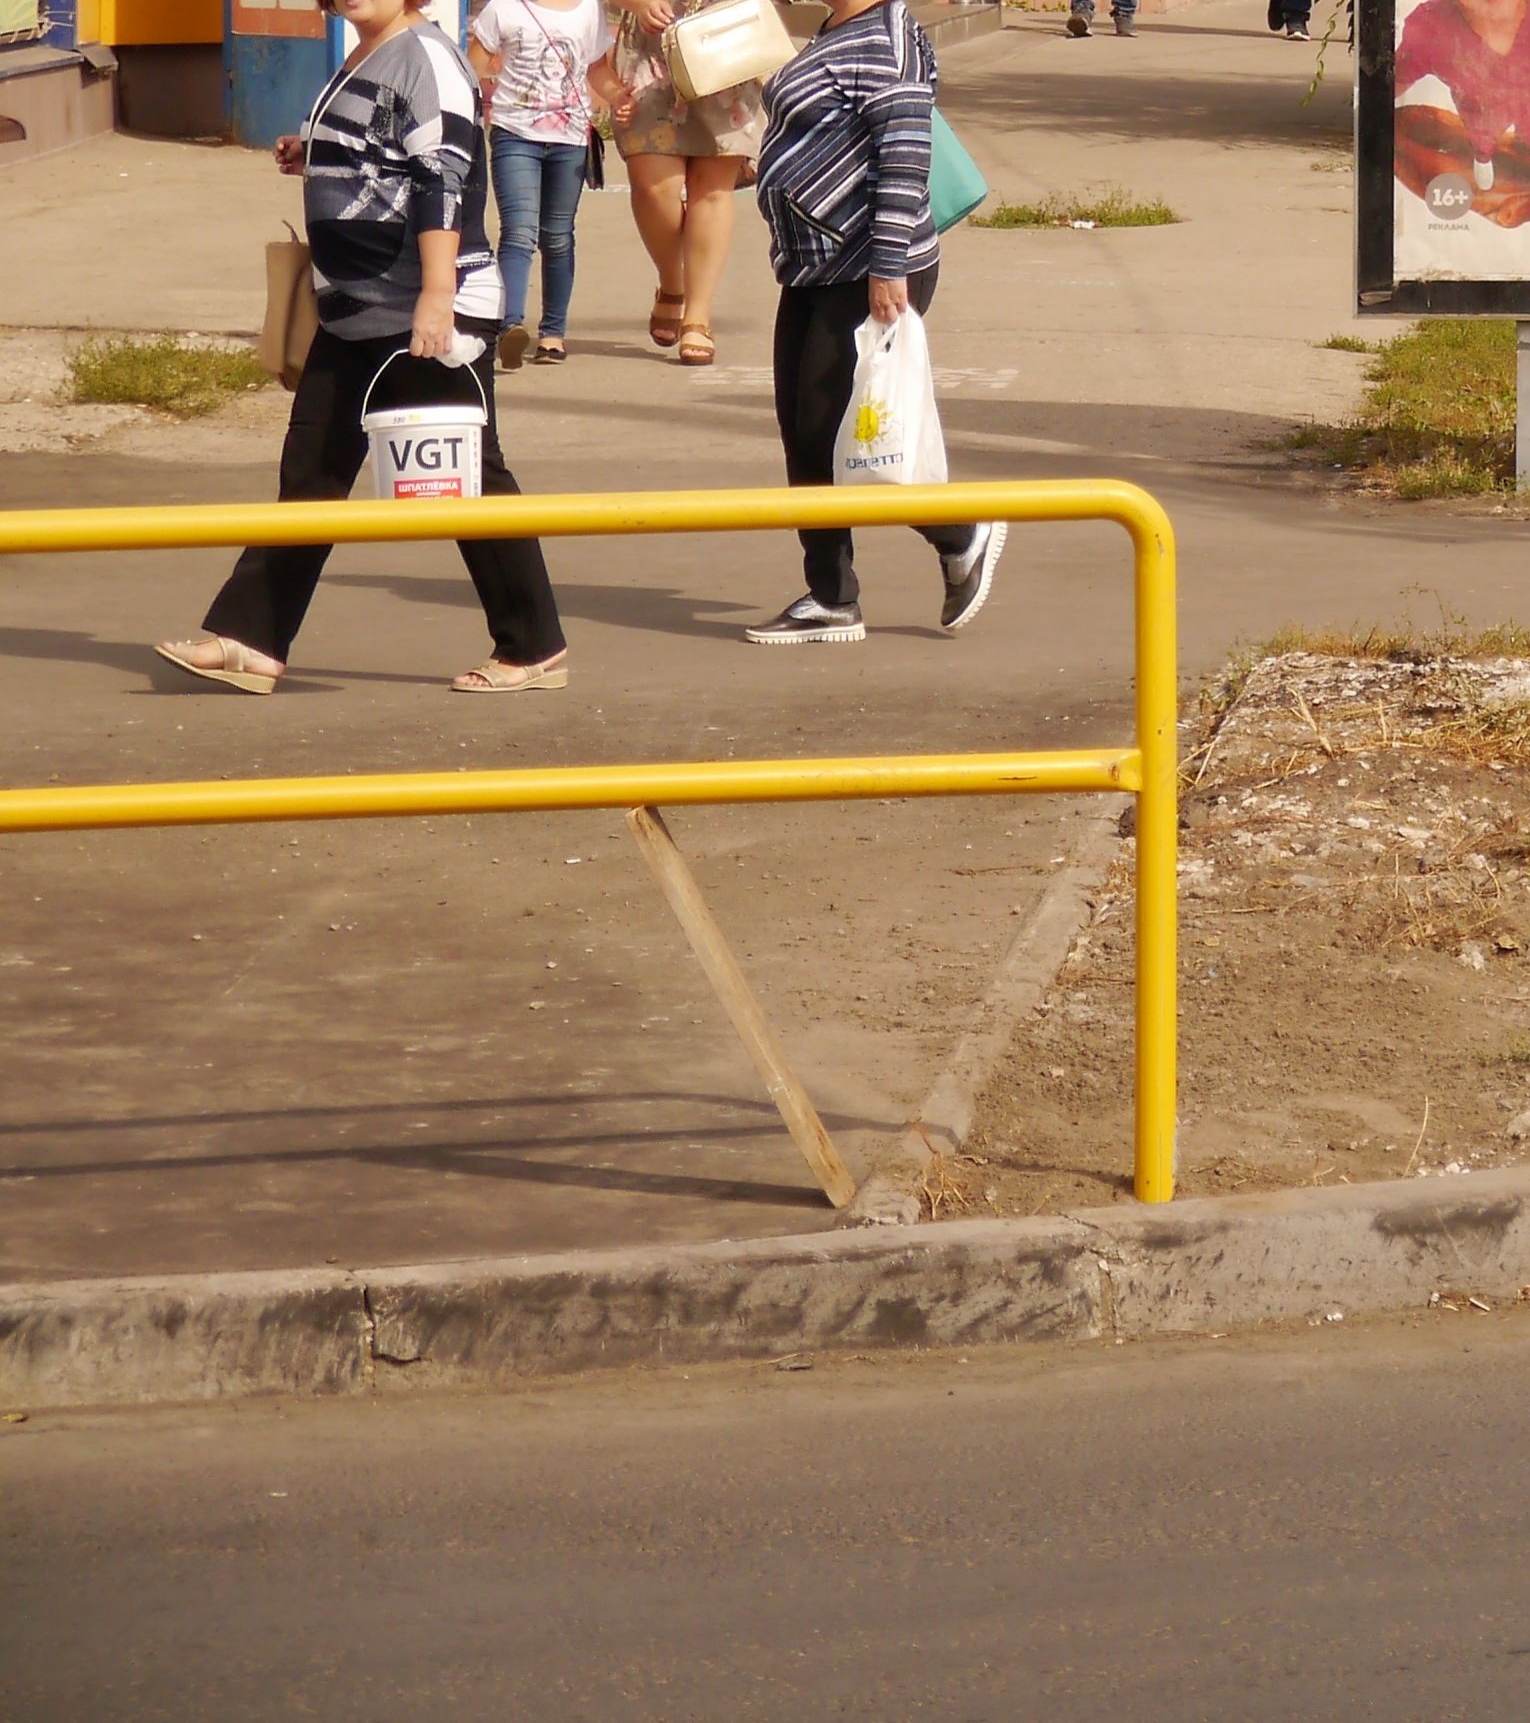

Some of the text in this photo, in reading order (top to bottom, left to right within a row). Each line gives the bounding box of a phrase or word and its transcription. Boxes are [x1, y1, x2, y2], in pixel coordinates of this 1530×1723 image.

[1432, 188, 1469, 206] 16+
[1427, 223, 1470, 231] РЕКЛАМА
[388, 437, 463, 472] VGT
